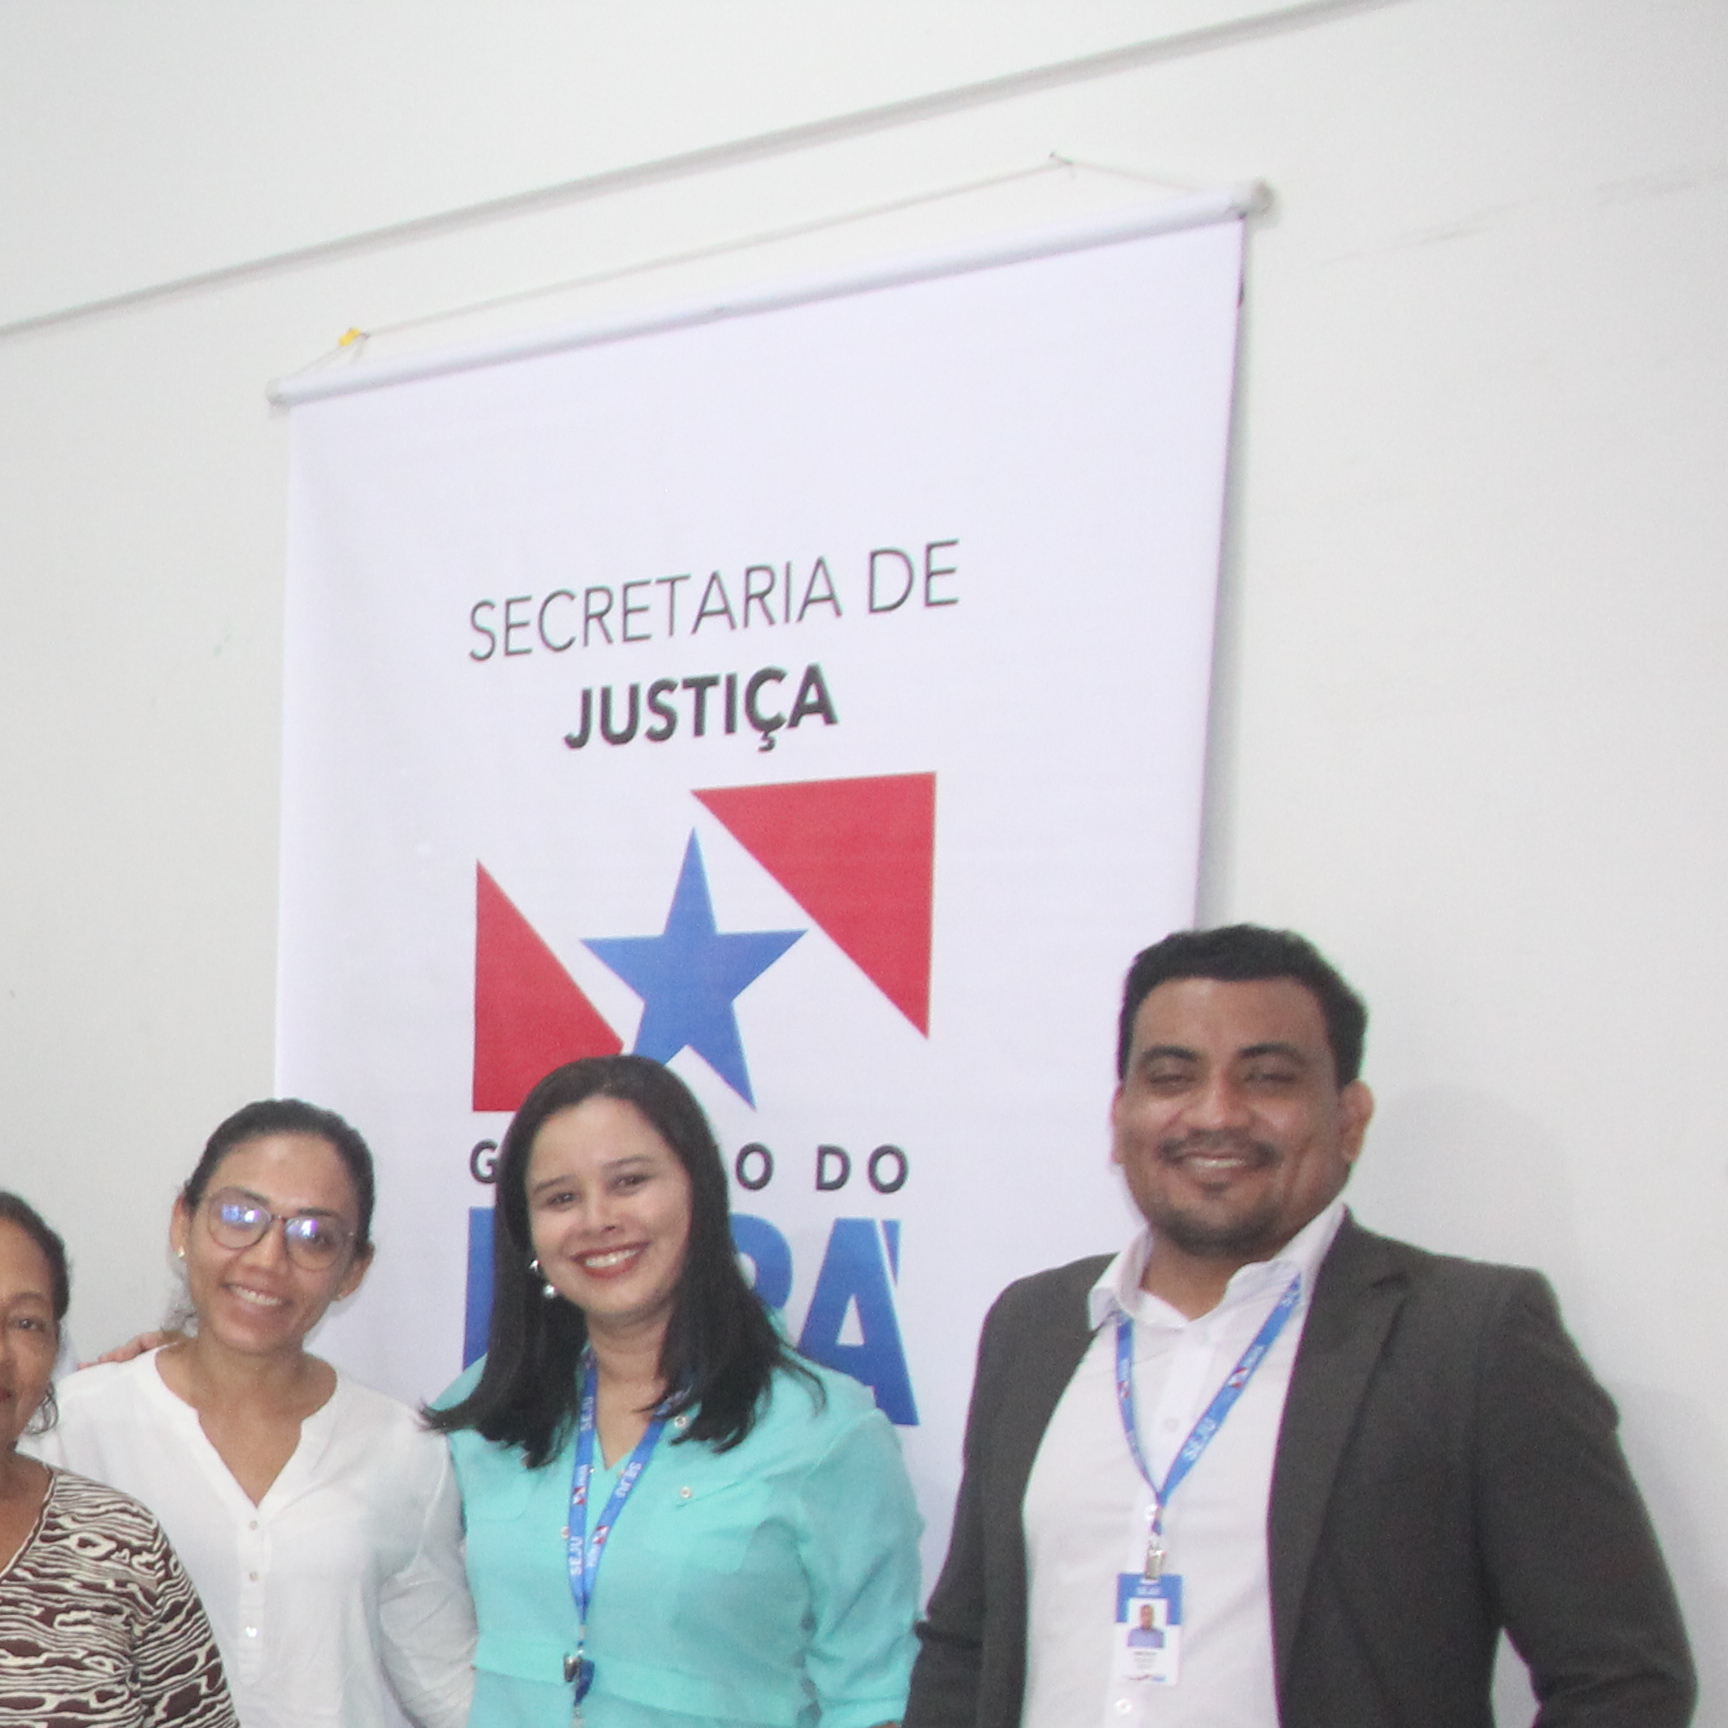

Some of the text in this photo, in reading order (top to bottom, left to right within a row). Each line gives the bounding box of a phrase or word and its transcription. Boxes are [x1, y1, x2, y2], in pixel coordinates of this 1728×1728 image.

[469, 538, 960, 662] SECRETARIA DE
[564, 662, 839, 753] JUSTIÇA
[815, 1144, 909, 1194] DO
[569, 1536, 583, 1576] SEJU
